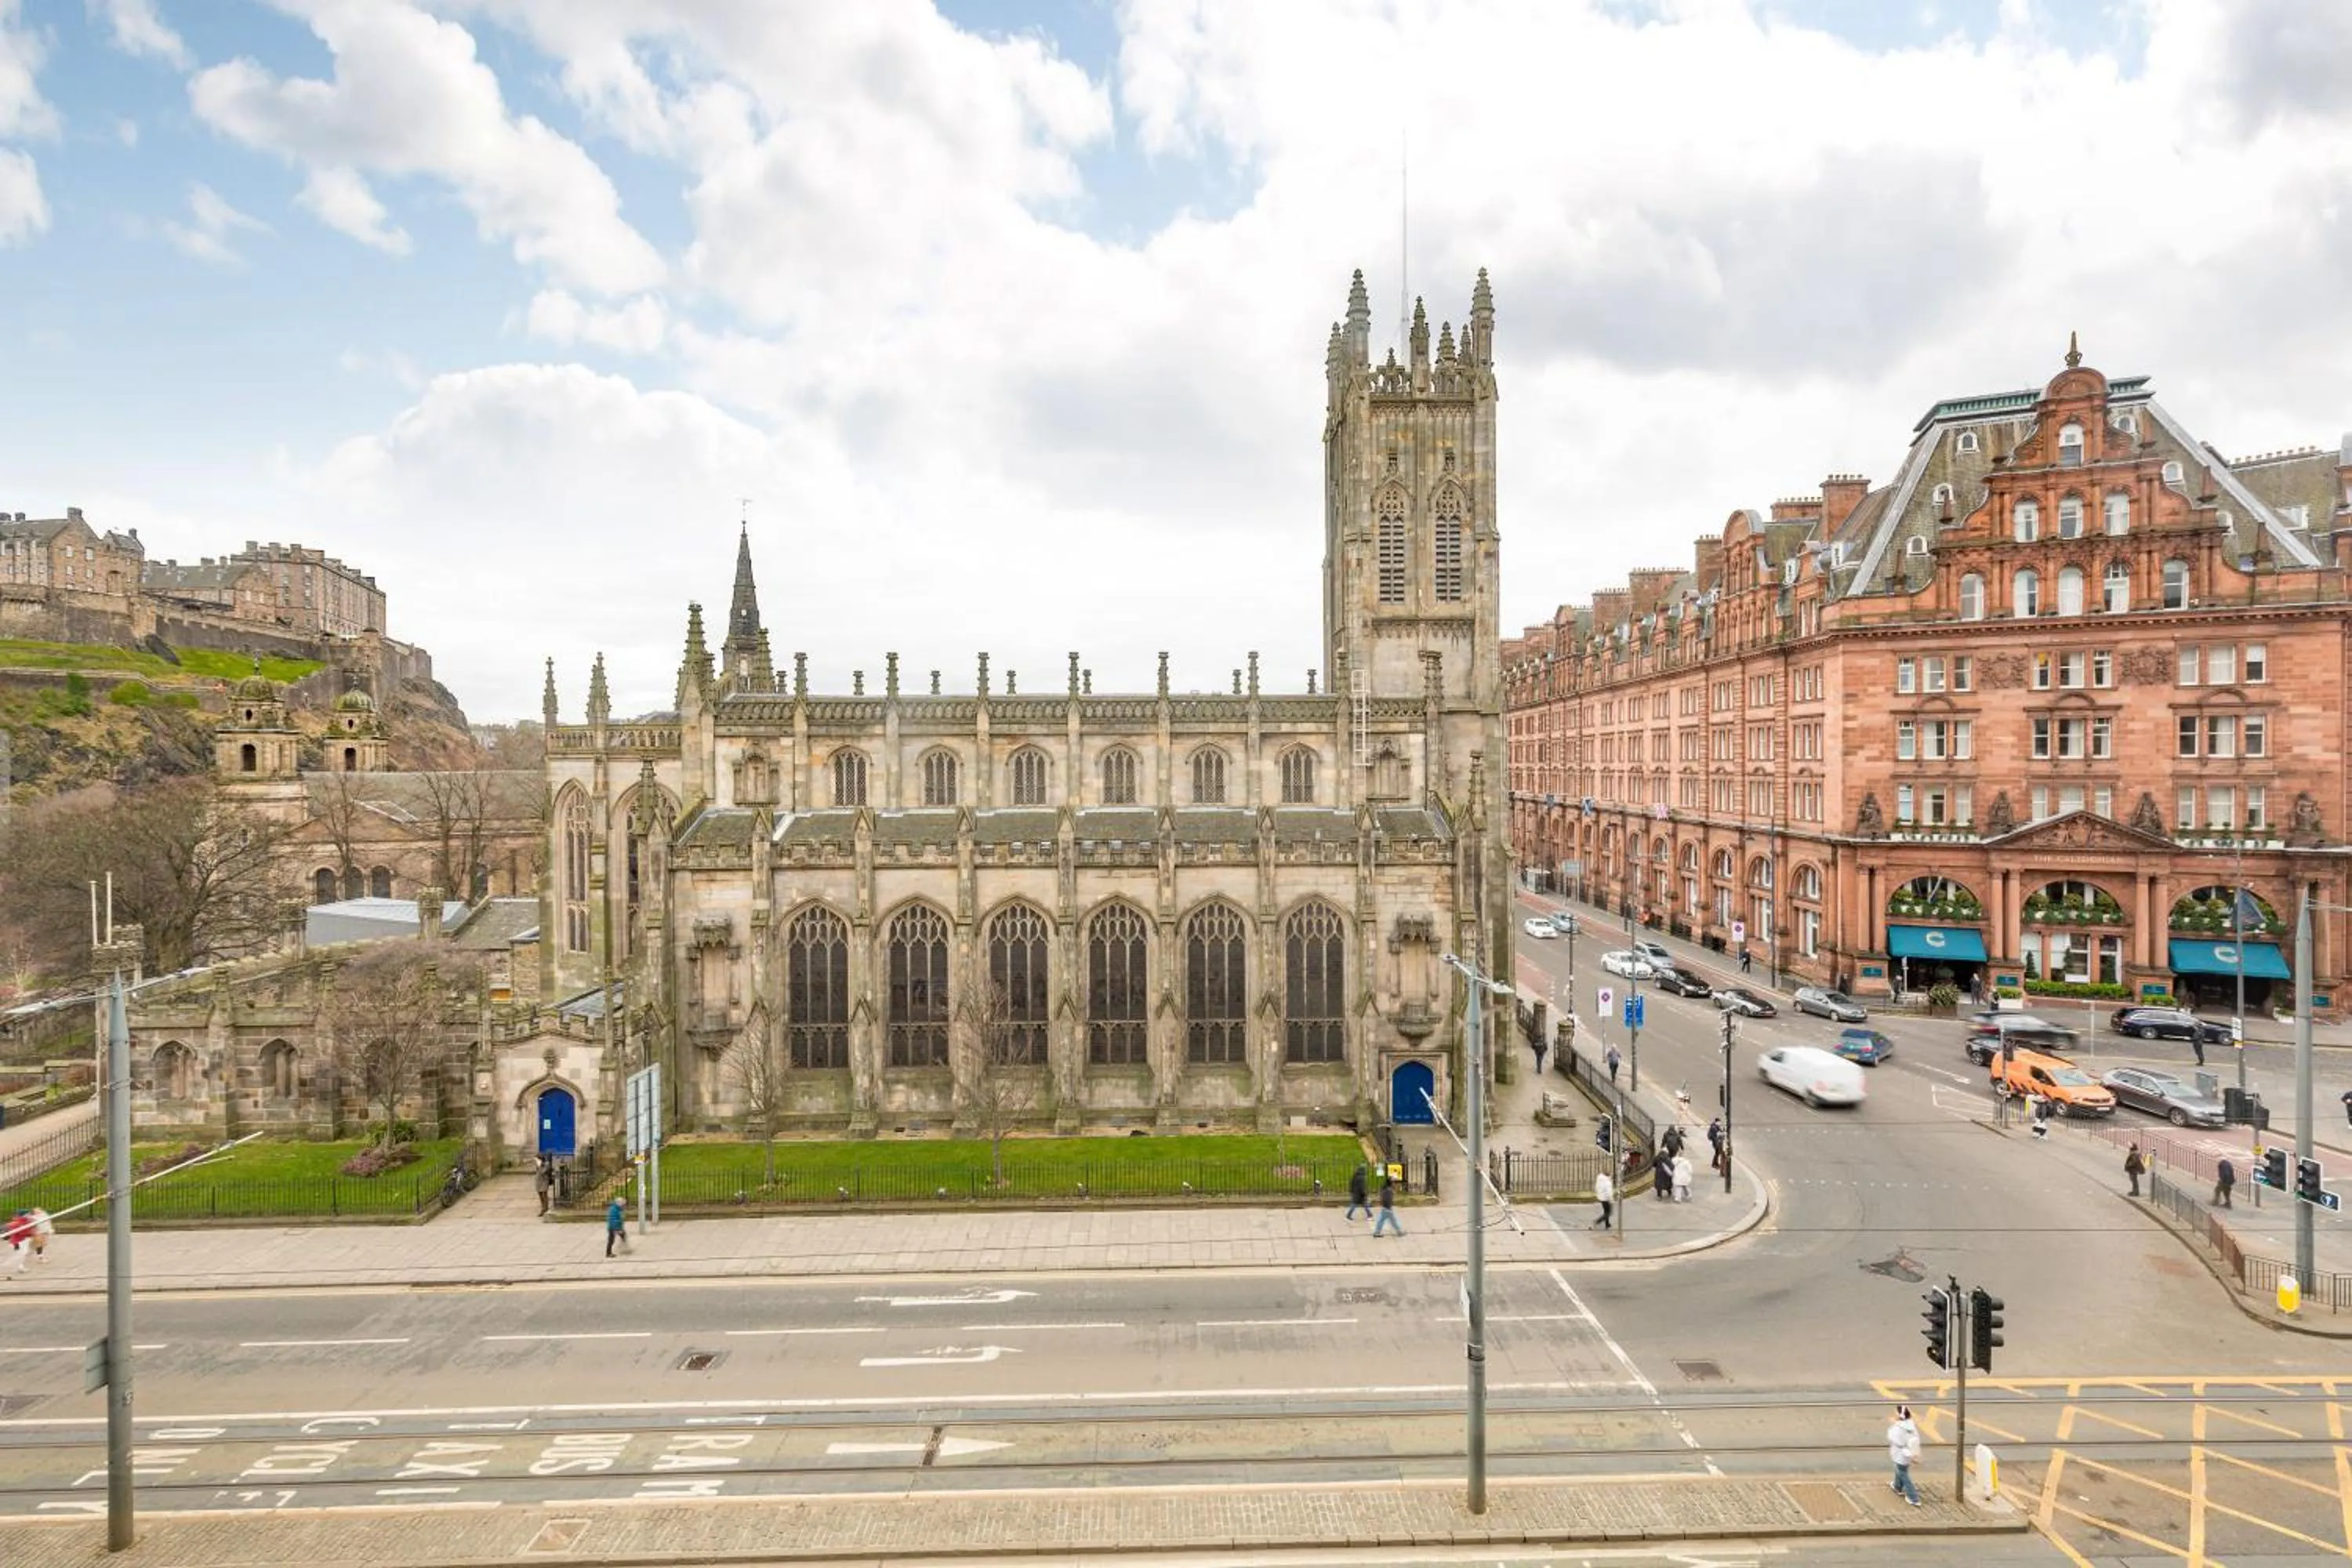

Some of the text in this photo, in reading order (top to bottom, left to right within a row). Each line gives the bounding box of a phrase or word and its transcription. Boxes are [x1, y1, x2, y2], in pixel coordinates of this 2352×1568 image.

[375, 1417, 530, 1494] TAXI
[528, 1433, 633, 1475] BUS
[633, 1415, 765, 1498] TRAM
